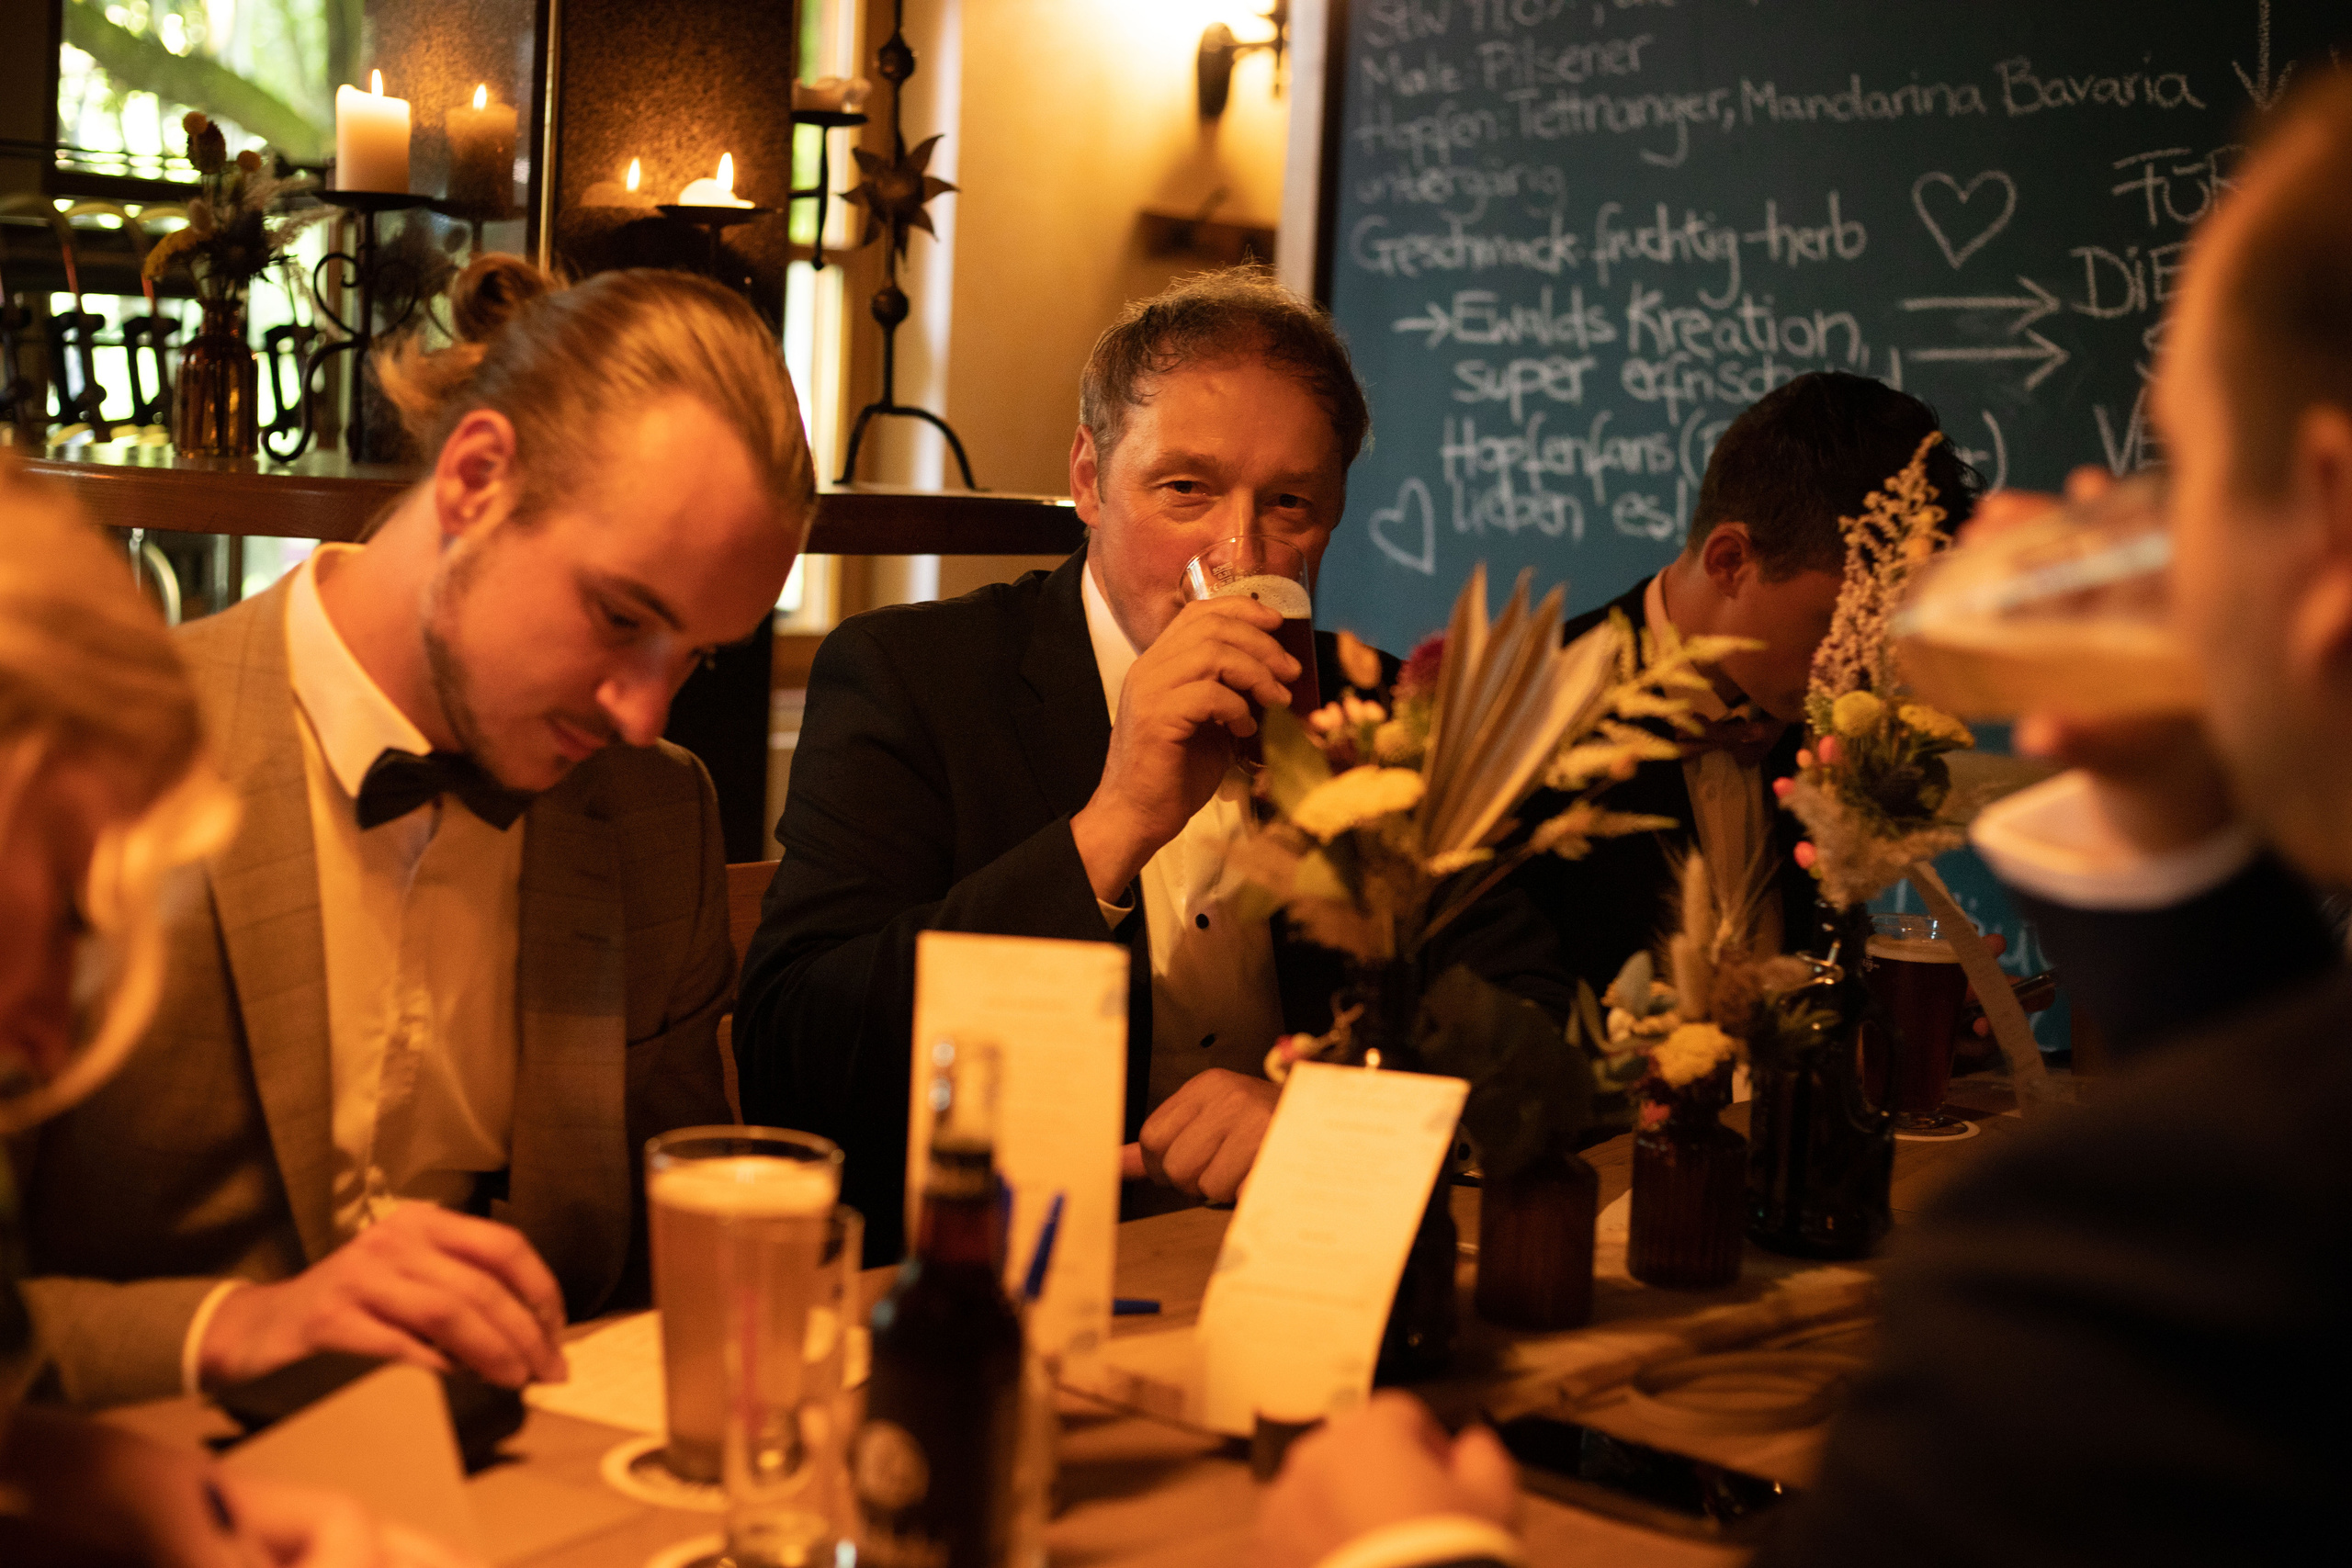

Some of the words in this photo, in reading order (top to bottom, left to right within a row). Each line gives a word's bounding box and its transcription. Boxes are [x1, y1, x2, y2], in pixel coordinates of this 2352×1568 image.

[1475, 34, 1653, 90] Pilsener
[1740, 72, 1987, 125] Mandarina
[1994, 51, 2207, 117] Bavaria
[1451, 283, 1618, 350] Ewalds
[1452, 352, 1597, 424] super
